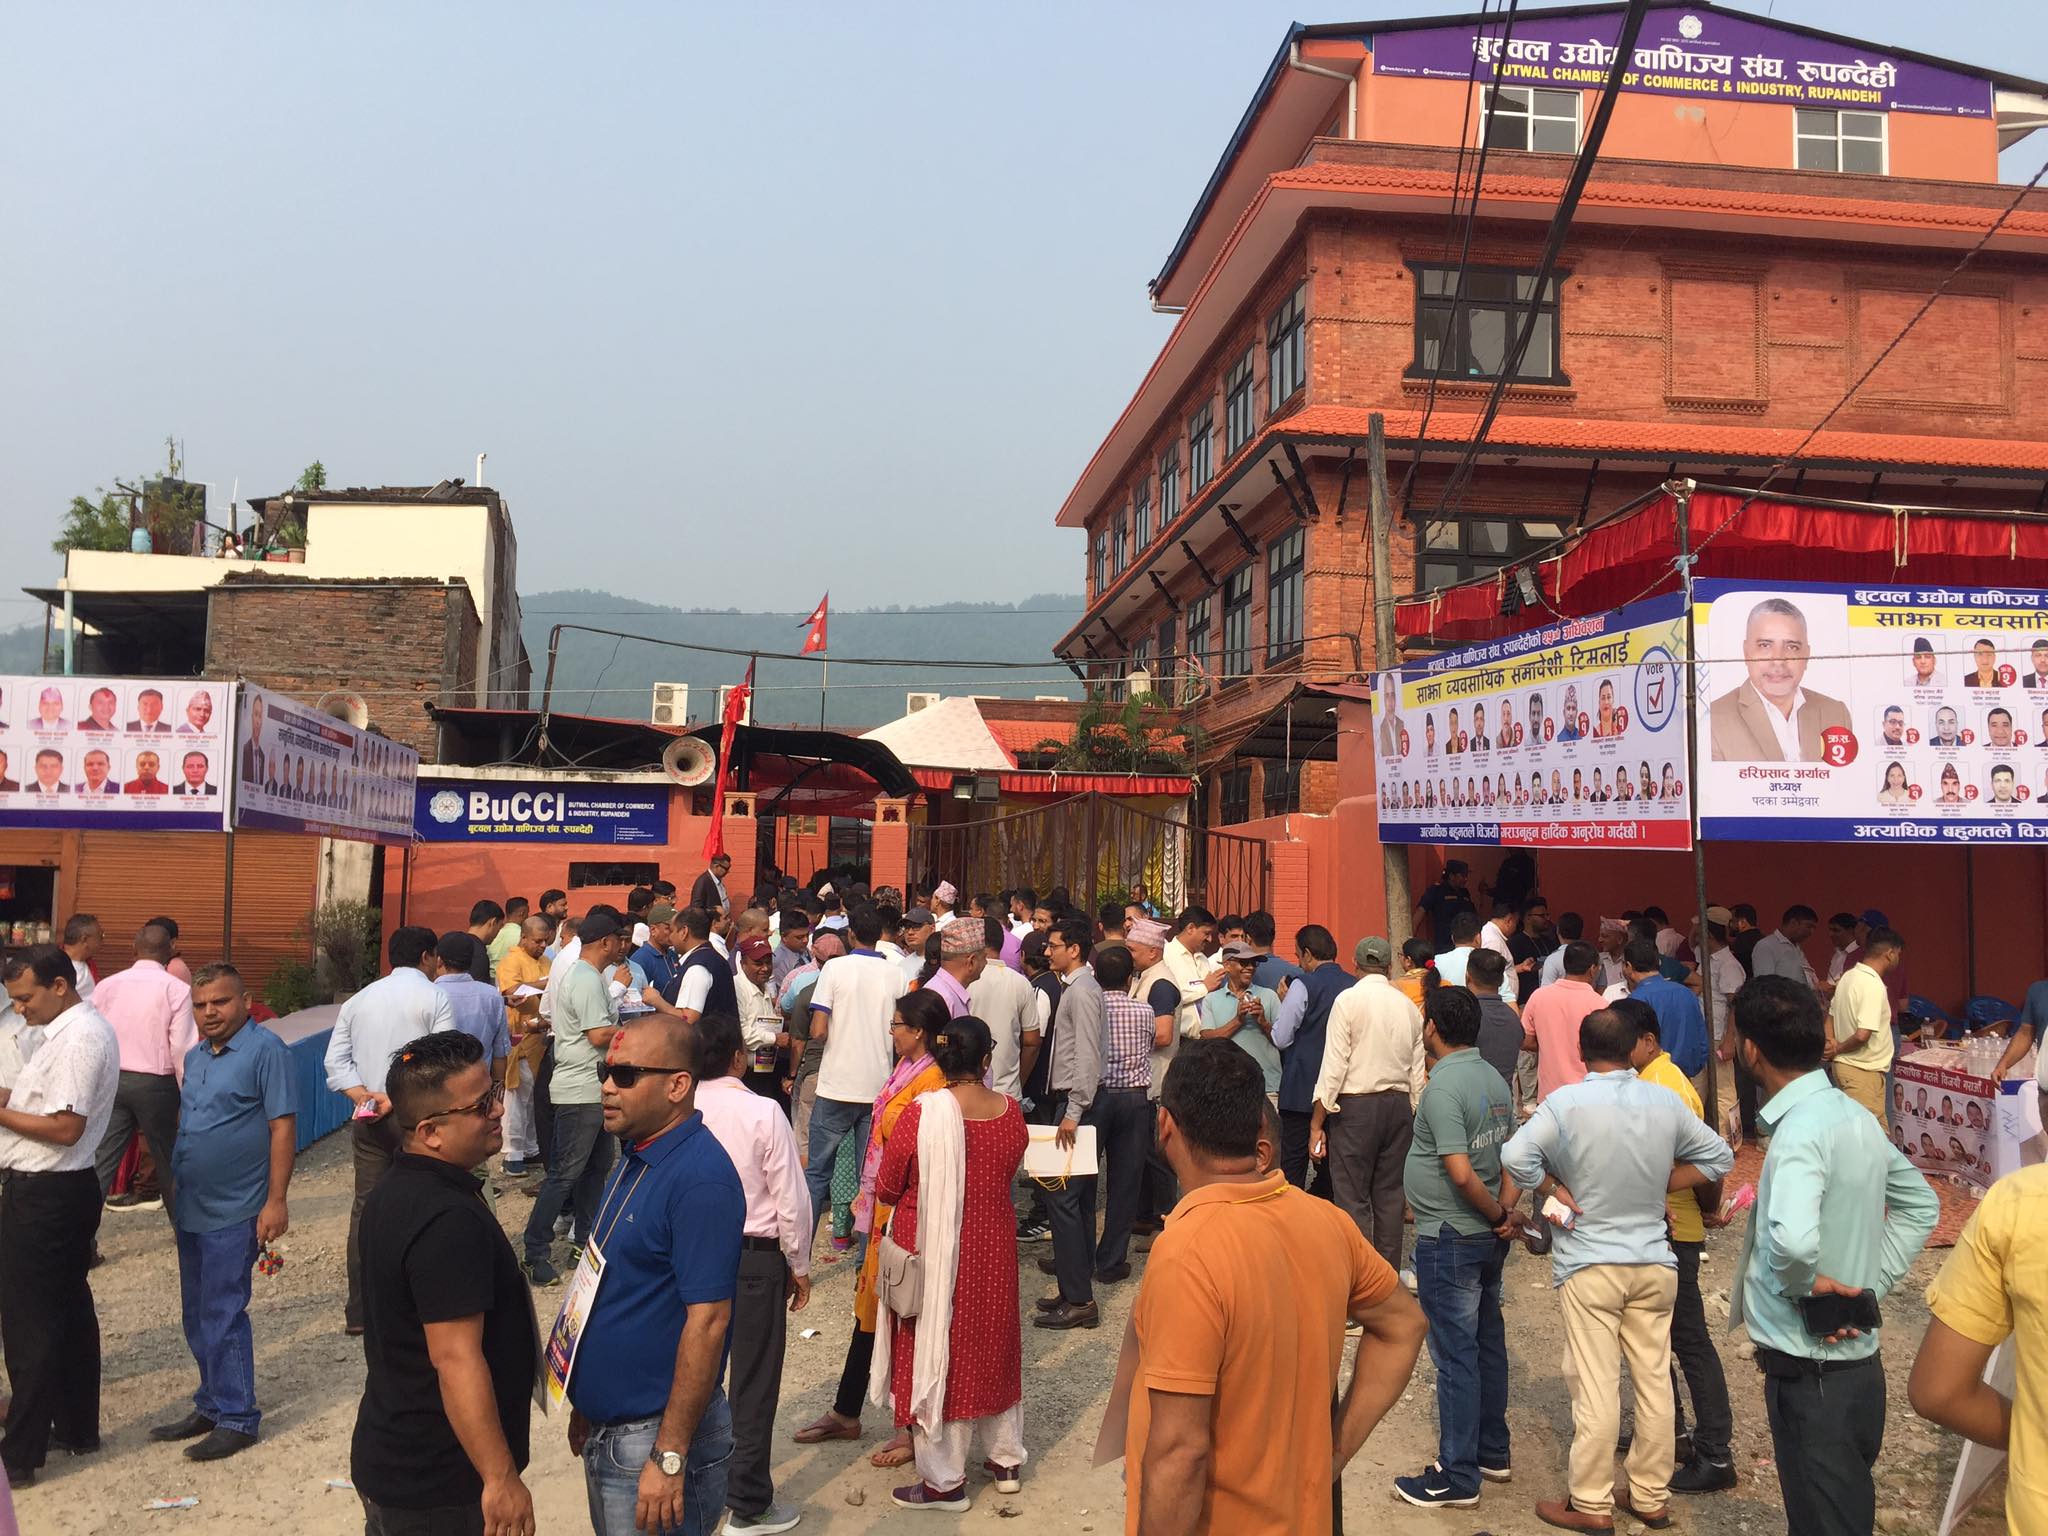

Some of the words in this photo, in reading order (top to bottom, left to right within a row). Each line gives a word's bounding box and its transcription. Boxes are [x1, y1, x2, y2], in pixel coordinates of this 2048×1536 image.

[1634, 44, 1733, 75] वाणिज्य
[1552, 67, 1610, 84] CHAMBE
[1622, 72, 1639, 86] OF
[1643, 74, 1719, 92] COMMERCE
[1723, 80, 1732, 92] &
[1736, 81, 1804, 99] INDUSTRY,
[1808, 86, 1882, 103] RUPANDEHI
[1855, 590, 1911, 604] बुटवल
[1917, 589, 1965, 604] उद्योग
[1970, 590, 2040, 606] वाणिज्य
[1875, 612, 1942, 627] साझा
[1462, 647, 1487, 663] वाणिज्य
[1416, 682, 1442, 704] साझा
[1446, 668, 1505, 695] व्यवसायिक
[1831, 744, 1847, 764] २
[1739, 766, 1790, 779] हरिप्रसाद
[1794, 768, 1830, 779] अर्याल
[1769, 782, 1801, 792] अध्यक्ष
[469, 791, 565, 821] BuCCI
[568, 801, 590, 809] BUTWAL
[1752, 796, 1777, 806] पदका
[1476, 824, 1499, 838] विजयी
[1541, 823, 1568, 840] हार्दिक
[1571, 822, 1605, 842] अनुरोध
[1854, 822, 1938, 838] अत्याधिक
[1943, 823, 2012, 841] बहुमतले
[1471, 1130, 1493, 1149] HOST
